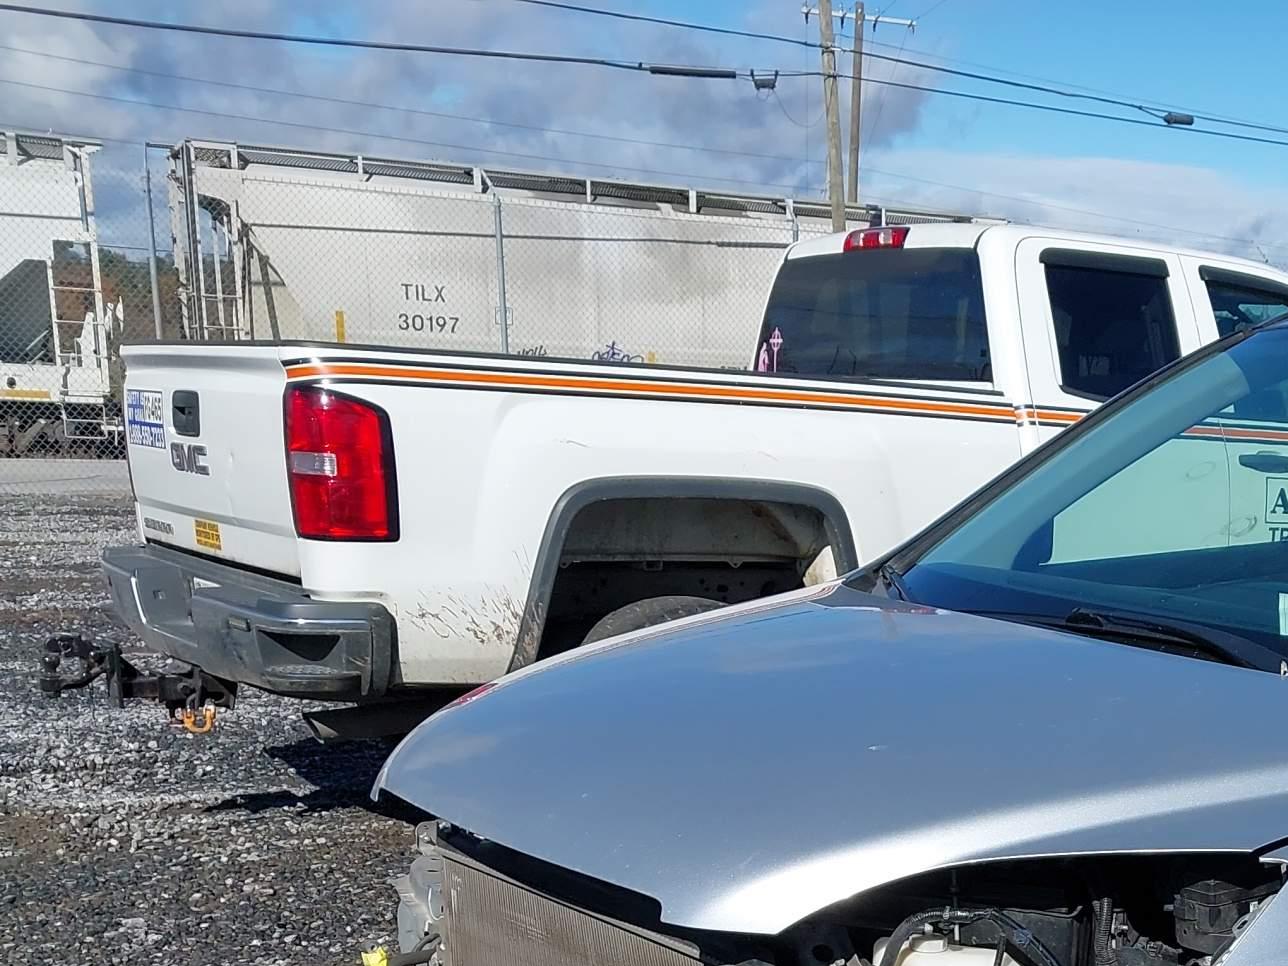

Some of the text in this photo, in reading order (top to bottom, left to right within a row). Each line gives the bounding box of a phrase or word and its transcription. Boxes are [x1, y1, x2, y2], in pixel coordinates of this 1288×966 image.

[401, 283, 446, 303] TILX
[398, 313, 460, 333] 30197
[170, 442, 210, 476] GMC
